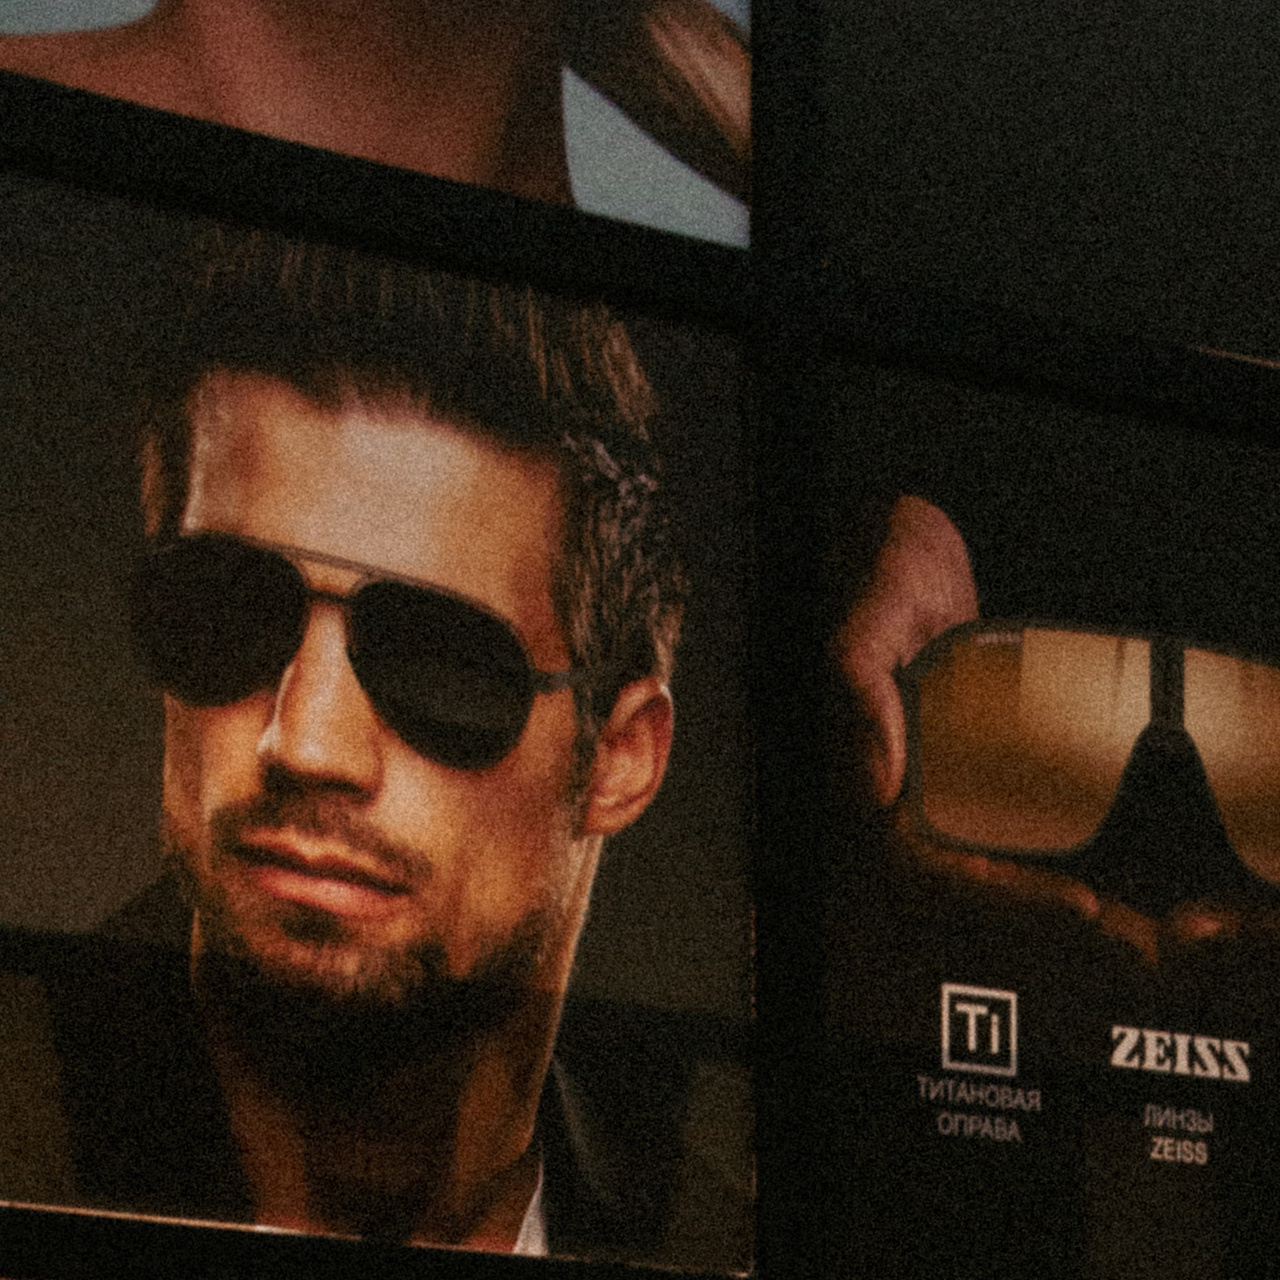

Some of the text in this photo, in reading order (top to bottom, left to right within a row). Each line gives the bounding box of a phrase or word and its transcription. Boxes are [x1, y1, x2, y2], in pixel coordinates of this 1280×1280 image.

[956, 1003, 1000, 1055] Ti
[1111, 1025, 1251, 1083] ZEISS
[918, 1075, 1042, 1112] ТИТАНОВАЯ
[938, 1111, 1023, 1143] ОПРАВА
[1144, 1103, 1214, 1133] ЛИНЗЫ
[1149, 1136, 1209, 1164] ZEISS
